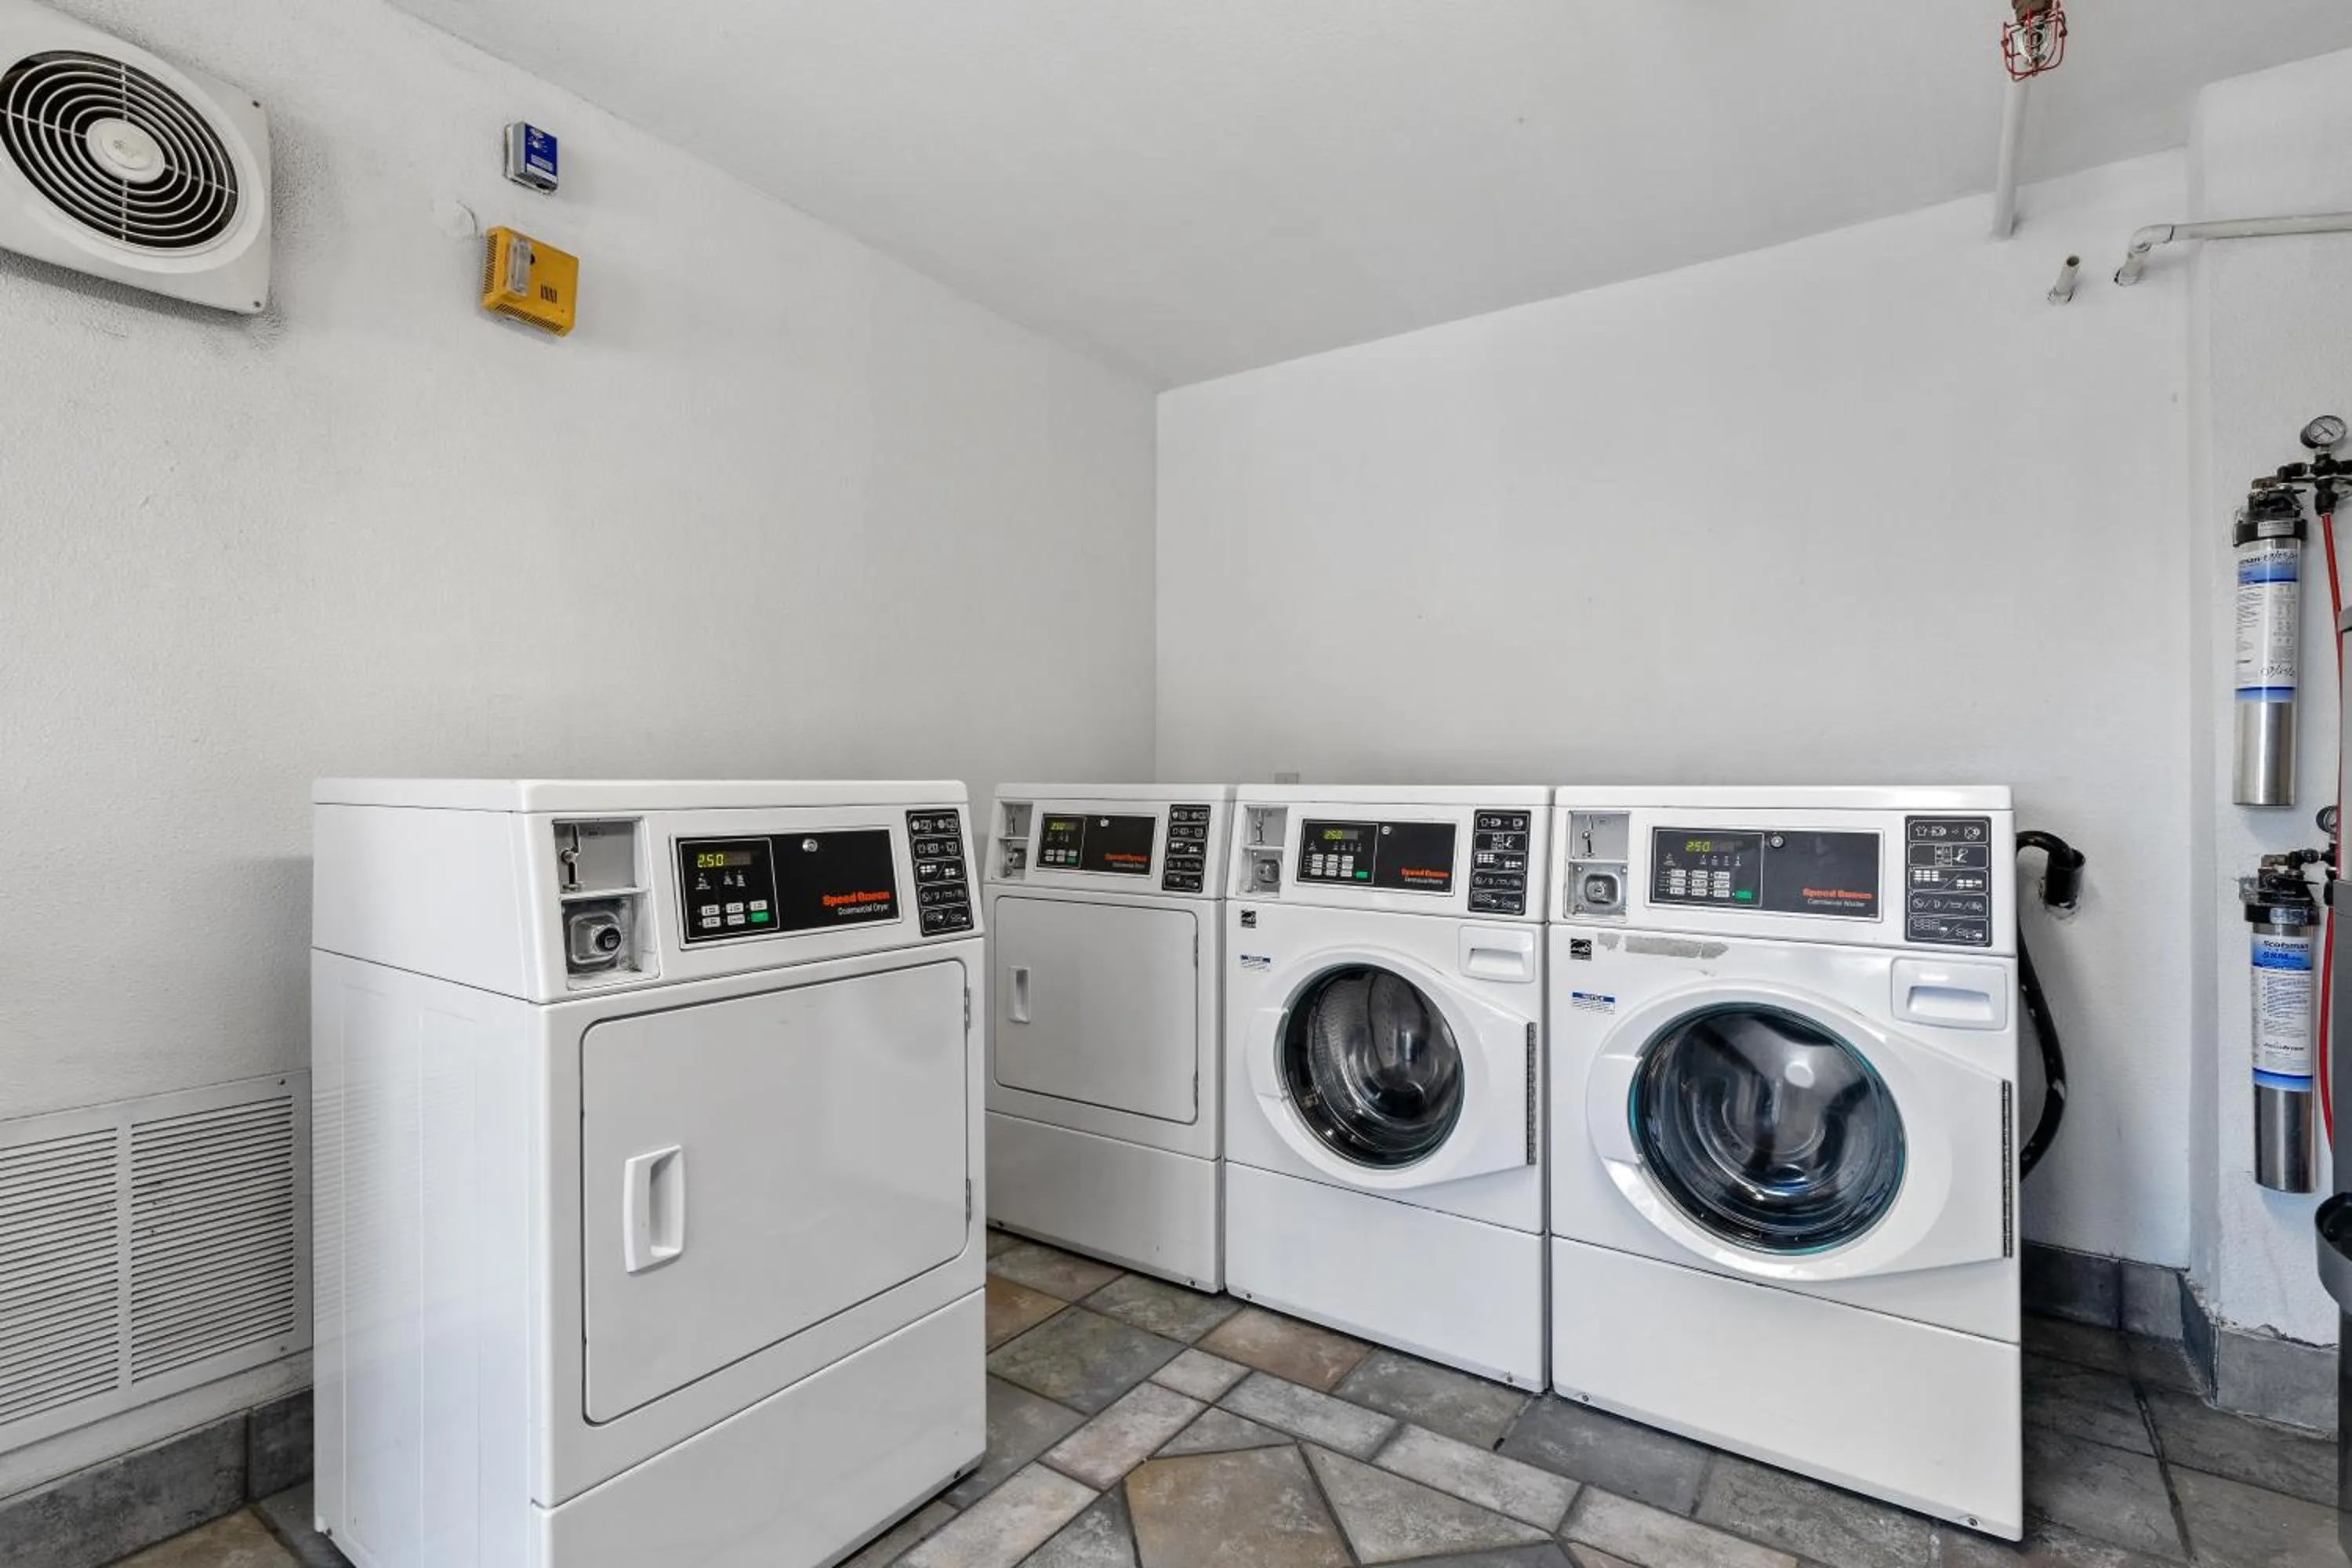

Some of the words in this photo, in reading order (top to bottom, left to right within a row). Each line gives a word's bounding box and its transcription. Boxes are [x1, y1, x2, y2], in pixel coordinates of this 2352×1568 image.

[822, 891, 857, 907] Speed
[857, 891, 891, 902] Queen
[1802, 888, 1837, 898] Speed
